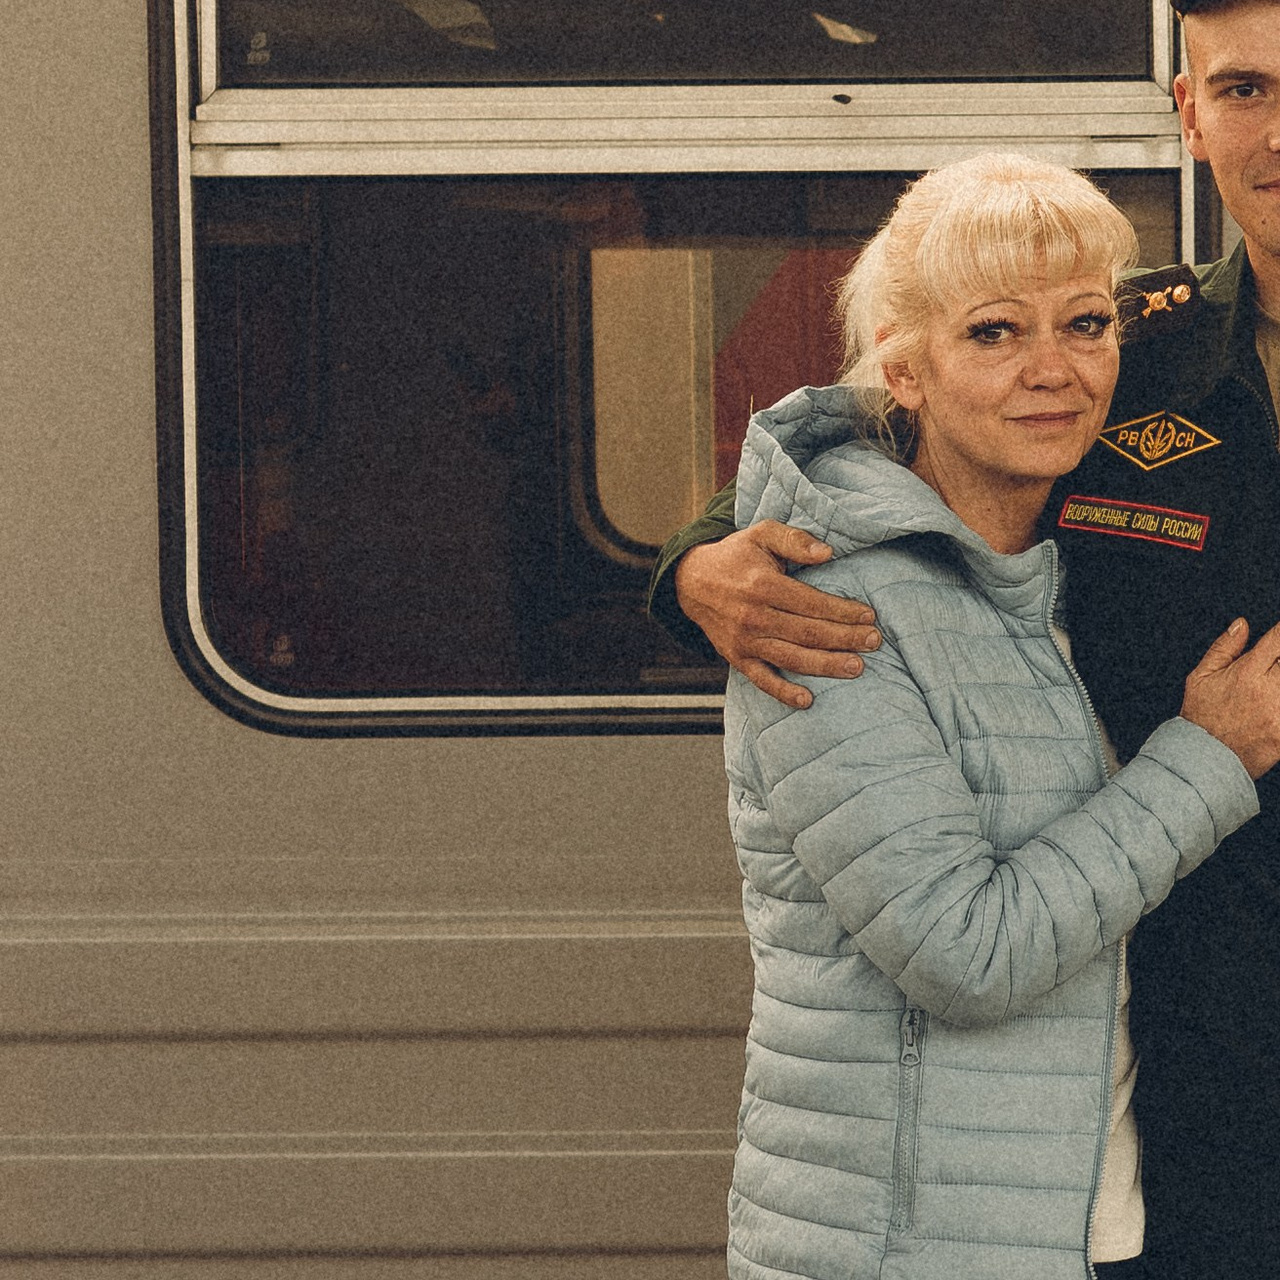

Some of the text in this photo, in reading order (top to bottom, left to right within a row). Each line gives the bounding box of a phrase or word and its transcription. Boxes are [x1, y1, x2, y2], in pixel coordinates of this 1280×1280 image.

[1065, 503, 1203, 540] ВООРУЖЕННЫЕ СИЛЫ РОССИИ
